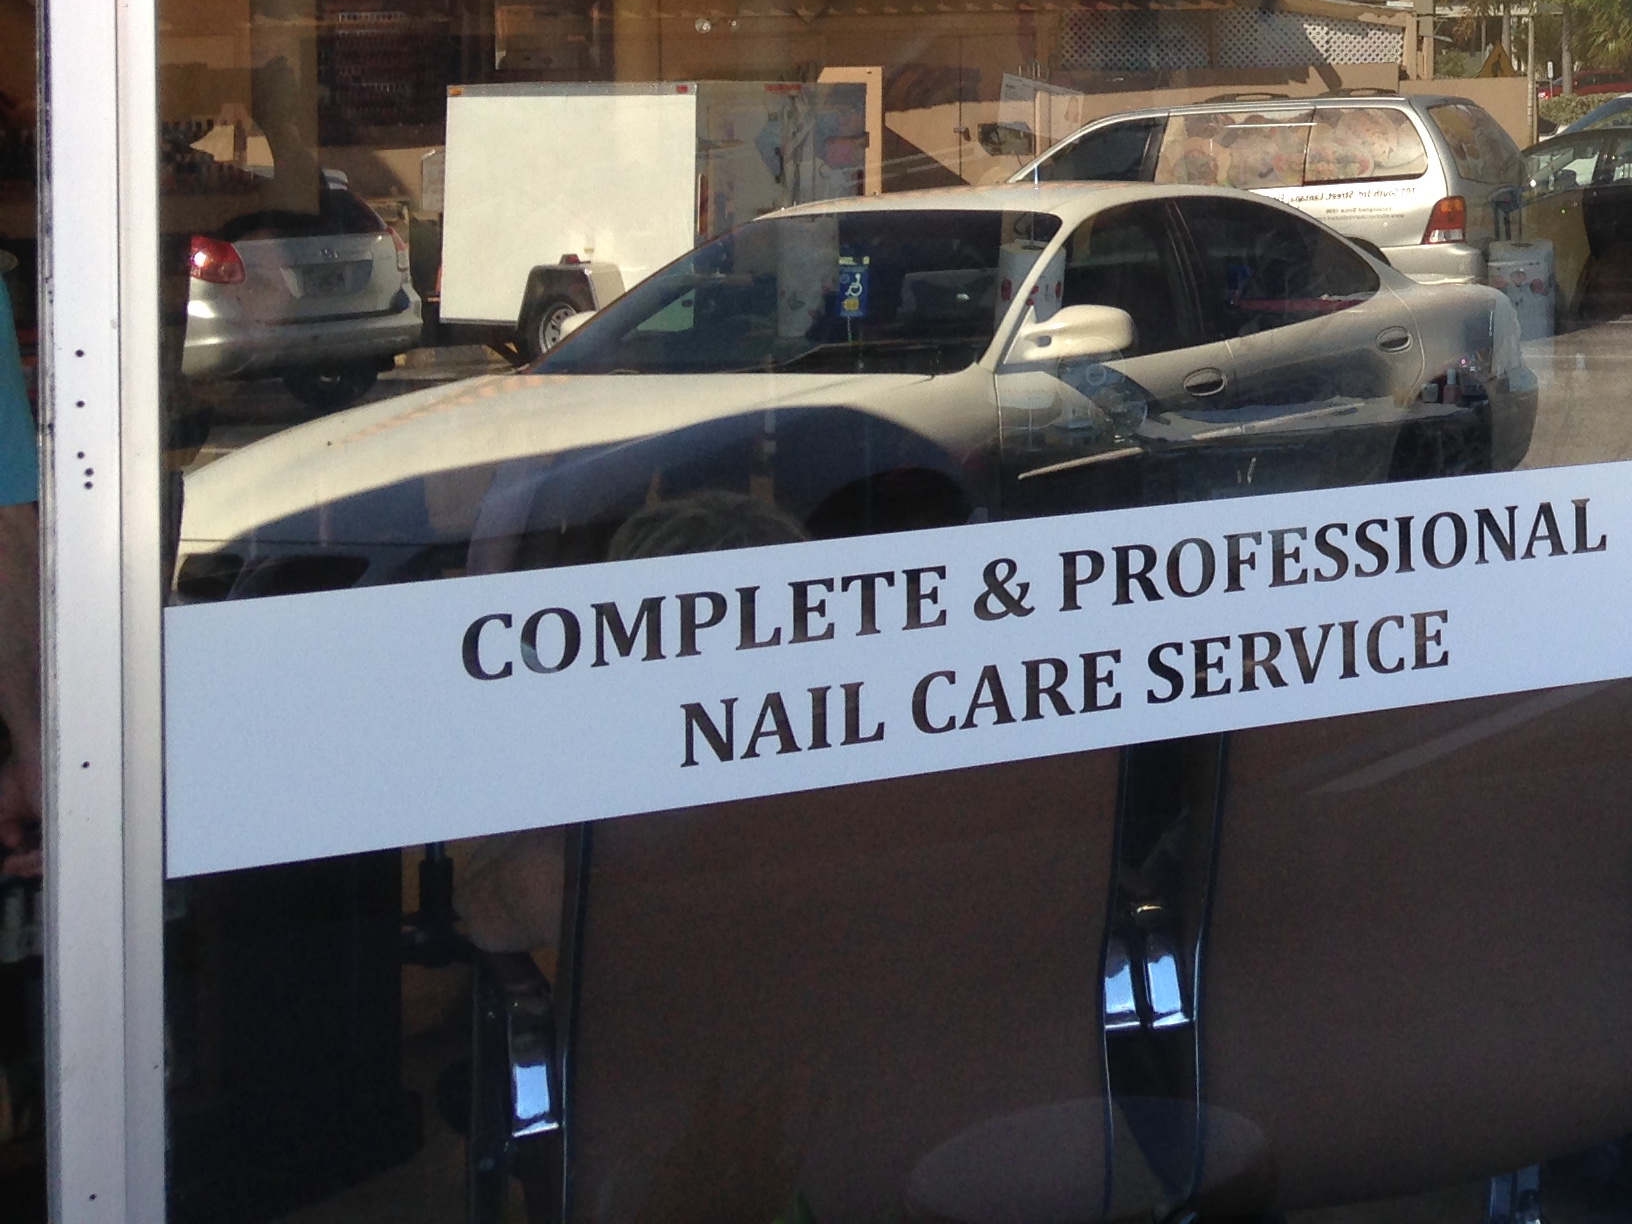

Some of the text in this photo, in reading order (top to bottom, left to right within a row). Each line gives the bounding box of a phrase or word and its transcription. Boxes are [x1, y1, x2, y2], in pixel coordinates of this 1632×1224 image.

[462, 498, 1607, 682] COMPLETE & PROFESSIONAL
[680, 609, 1450, 768] NAIL CARE SERVICE
